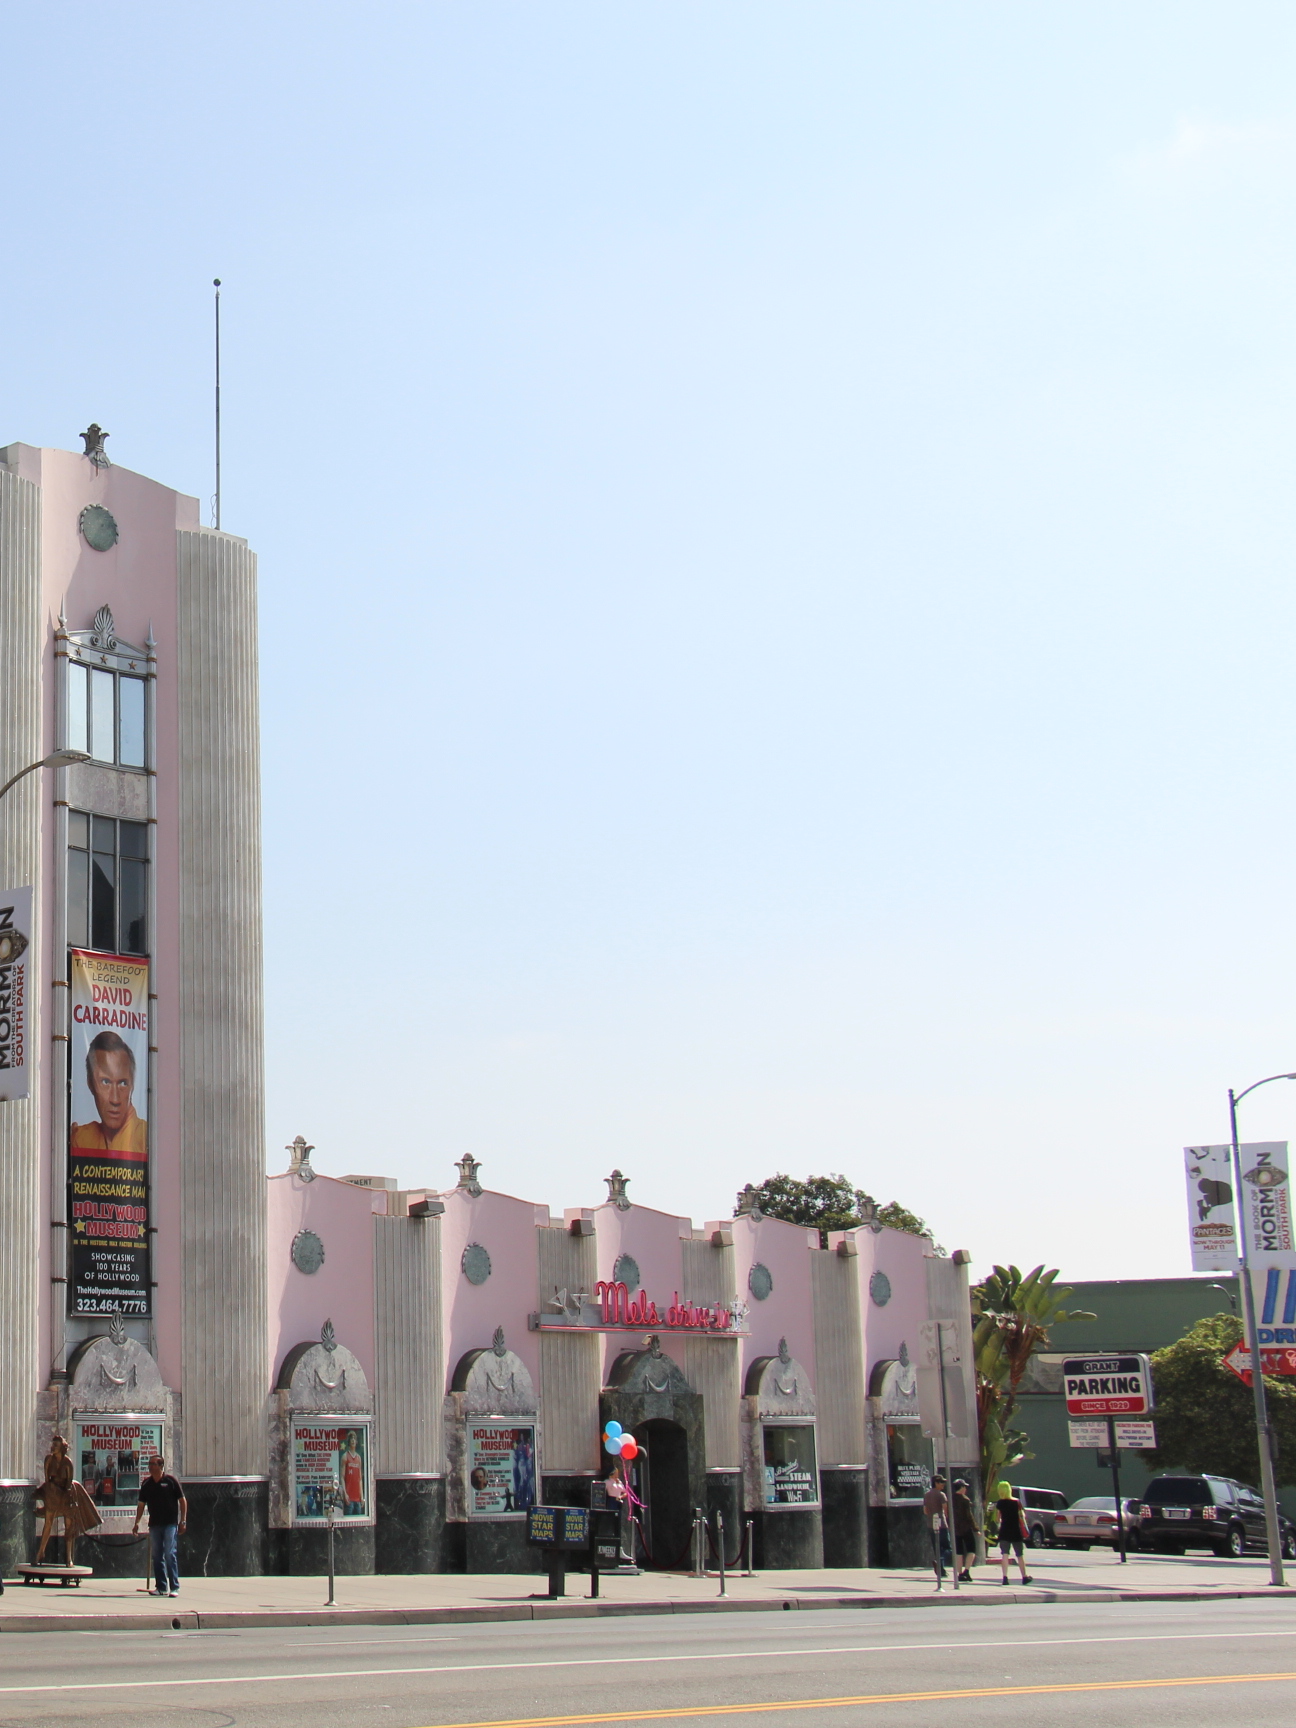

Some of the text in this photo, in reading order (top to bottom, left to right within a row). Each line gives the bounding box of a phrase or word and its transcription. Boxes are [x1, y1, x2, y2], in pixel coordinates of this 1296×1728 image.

[12, 965, 17, 976] OF
[75, 959, 146, 976] THE BAREFOOT
[92, 972, 130, 985] LEGEND
[92, 984, 133, 1007] DAVID
[16, 963, 24, 1067] SOUTH PARK
[73, 1004, 147, 1031] CARRADINE
[73, 1164, 80, 1177] A
[74, 1182, 145, 1199] RENAISSANCE MAN
[72, 1200, 146, 1222] HOLLYWOOD
[1251, 1189, 1262, 1251] THE BOOK OF
[1279, 1188, 1291, 1250] SOUTH PARK
[86, 1221, 139, 1239] MUSEUM
[1193, 1226, 1233, 1235] PANTAGES
[91, 1252, 135, 1262] SHOWCASING
[96, 1263, 131, 1272] 100 YEARS
[84, 1272, 140, 1282] OF HOLLYWOOD
[77, 1298, 147, 1313] 323.464.7776
[595, 1281, 663, 1326] Mels
[1257, 1329, 1296, 1344] DR
[1084, 1361, 1120, 1372] GRANT
[1067, 1376, 1141, 1395] PARKING
[1081, 1400, 1130, 1410] SINCE 1929
[81, 1424, 141, 1438] HOLLYWOOD
[91, 1439, 133, 1450] MUSEUM
[304, 1441, 341, 1451] MUSEUM
[481, 1441, 514, 1450] MUSEUM
[789, 1472, 812, 1481] STEAK
[532, 1513, 554, 1522] MOVIE
[532, 1522, 553, 1530] STAR
[565, 1523, 583, 1531] STAR
[531, 1530, 553, 1538] MAPS
